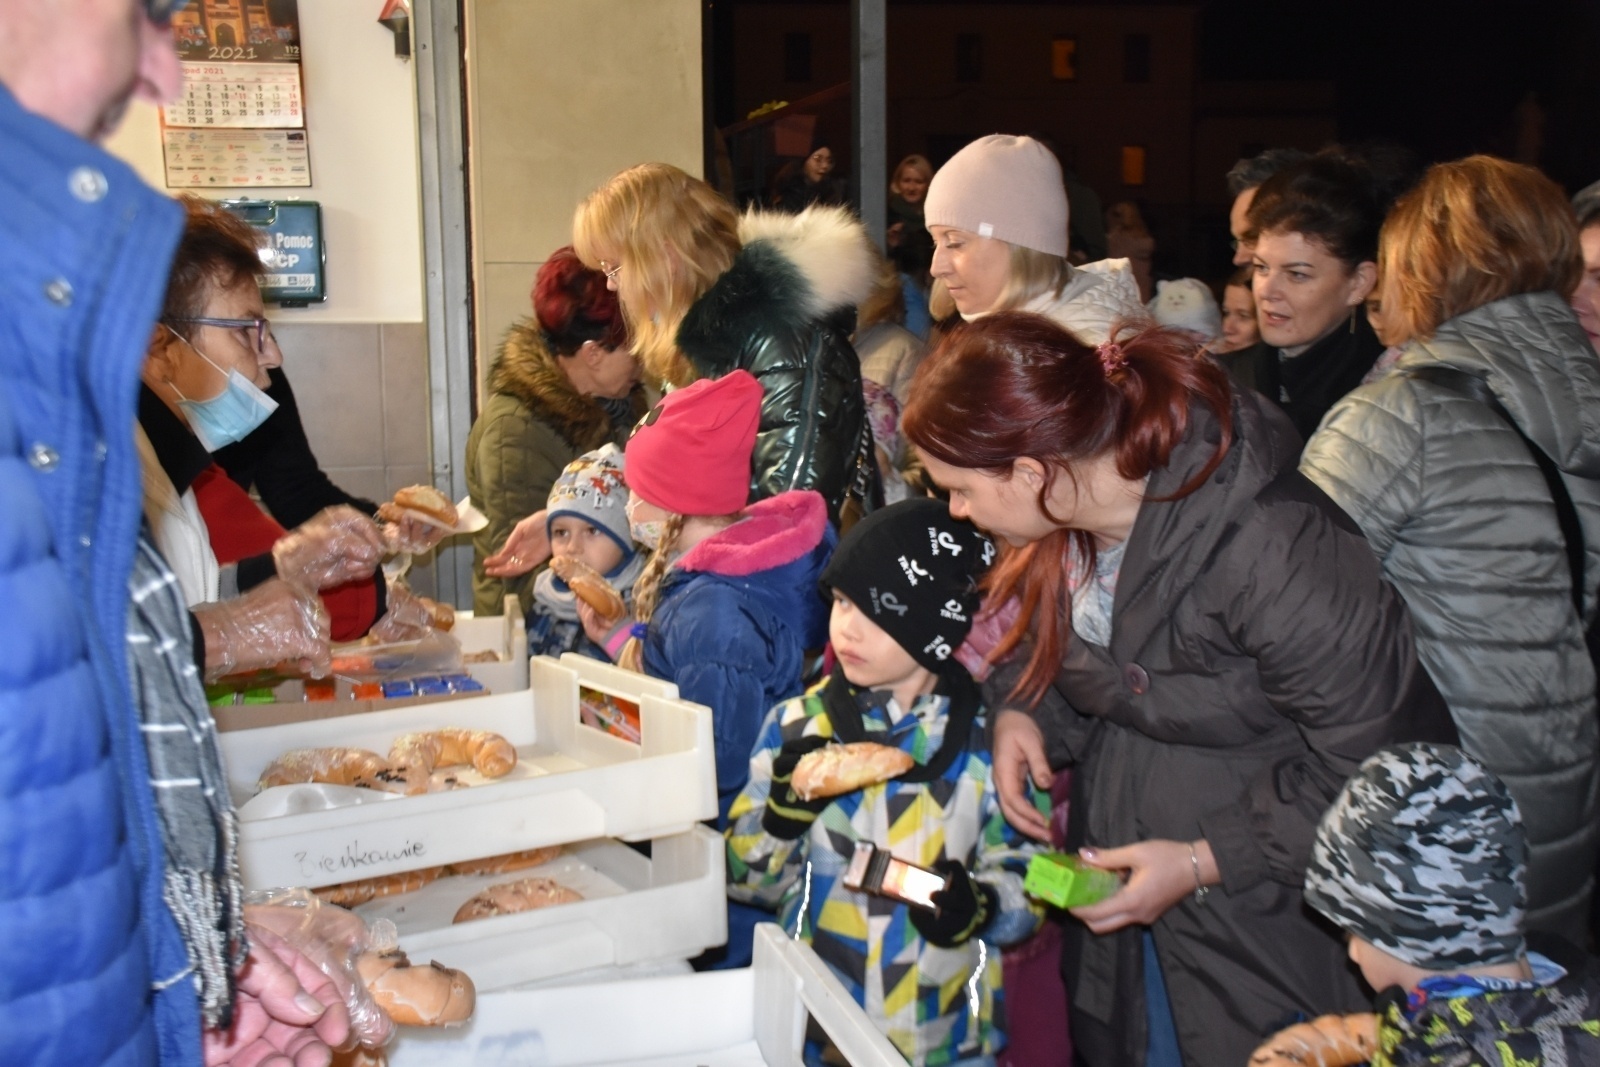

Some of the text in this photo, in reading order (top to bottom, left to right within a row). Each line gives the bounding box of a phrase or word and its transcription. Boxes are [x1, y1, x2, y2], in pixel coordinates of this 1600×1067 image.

[208, 46, 258, 59] 2021
[285, 45, 300, 54] 112
[203, 67, 225, 75] 2021
[275, 232, 314, 249] Pomoc
[927, 526, 940, 556] TikTok
[897, 554, 918, 587] TikTok
[939, 608, 968, 623] TikTok
